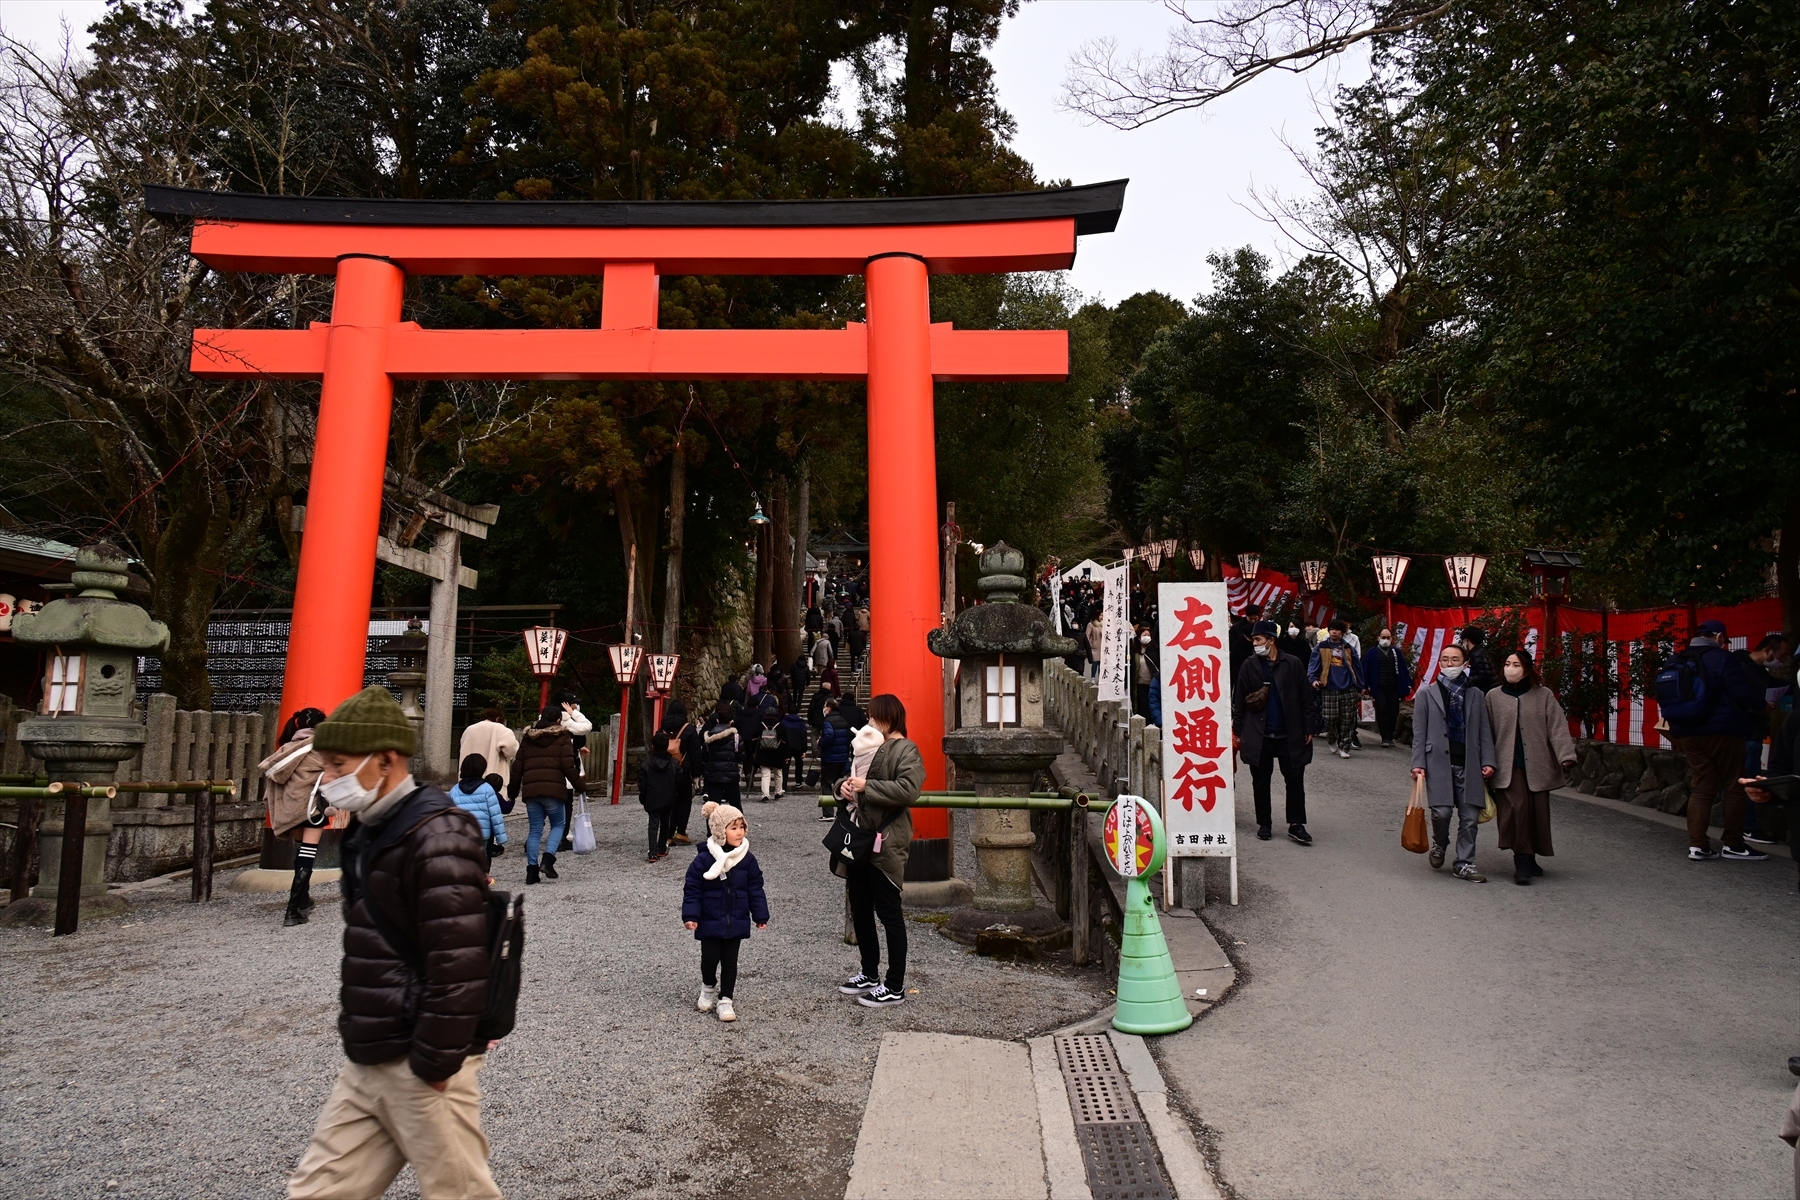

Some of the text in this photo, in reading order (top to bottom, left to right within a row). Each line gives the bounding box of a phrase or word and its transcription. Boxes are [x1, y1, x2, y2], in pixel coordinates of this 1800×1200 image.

[1165, 596, 1228, 813] 左側通行
[1175, 834, 1228, 845] 吉田神社
